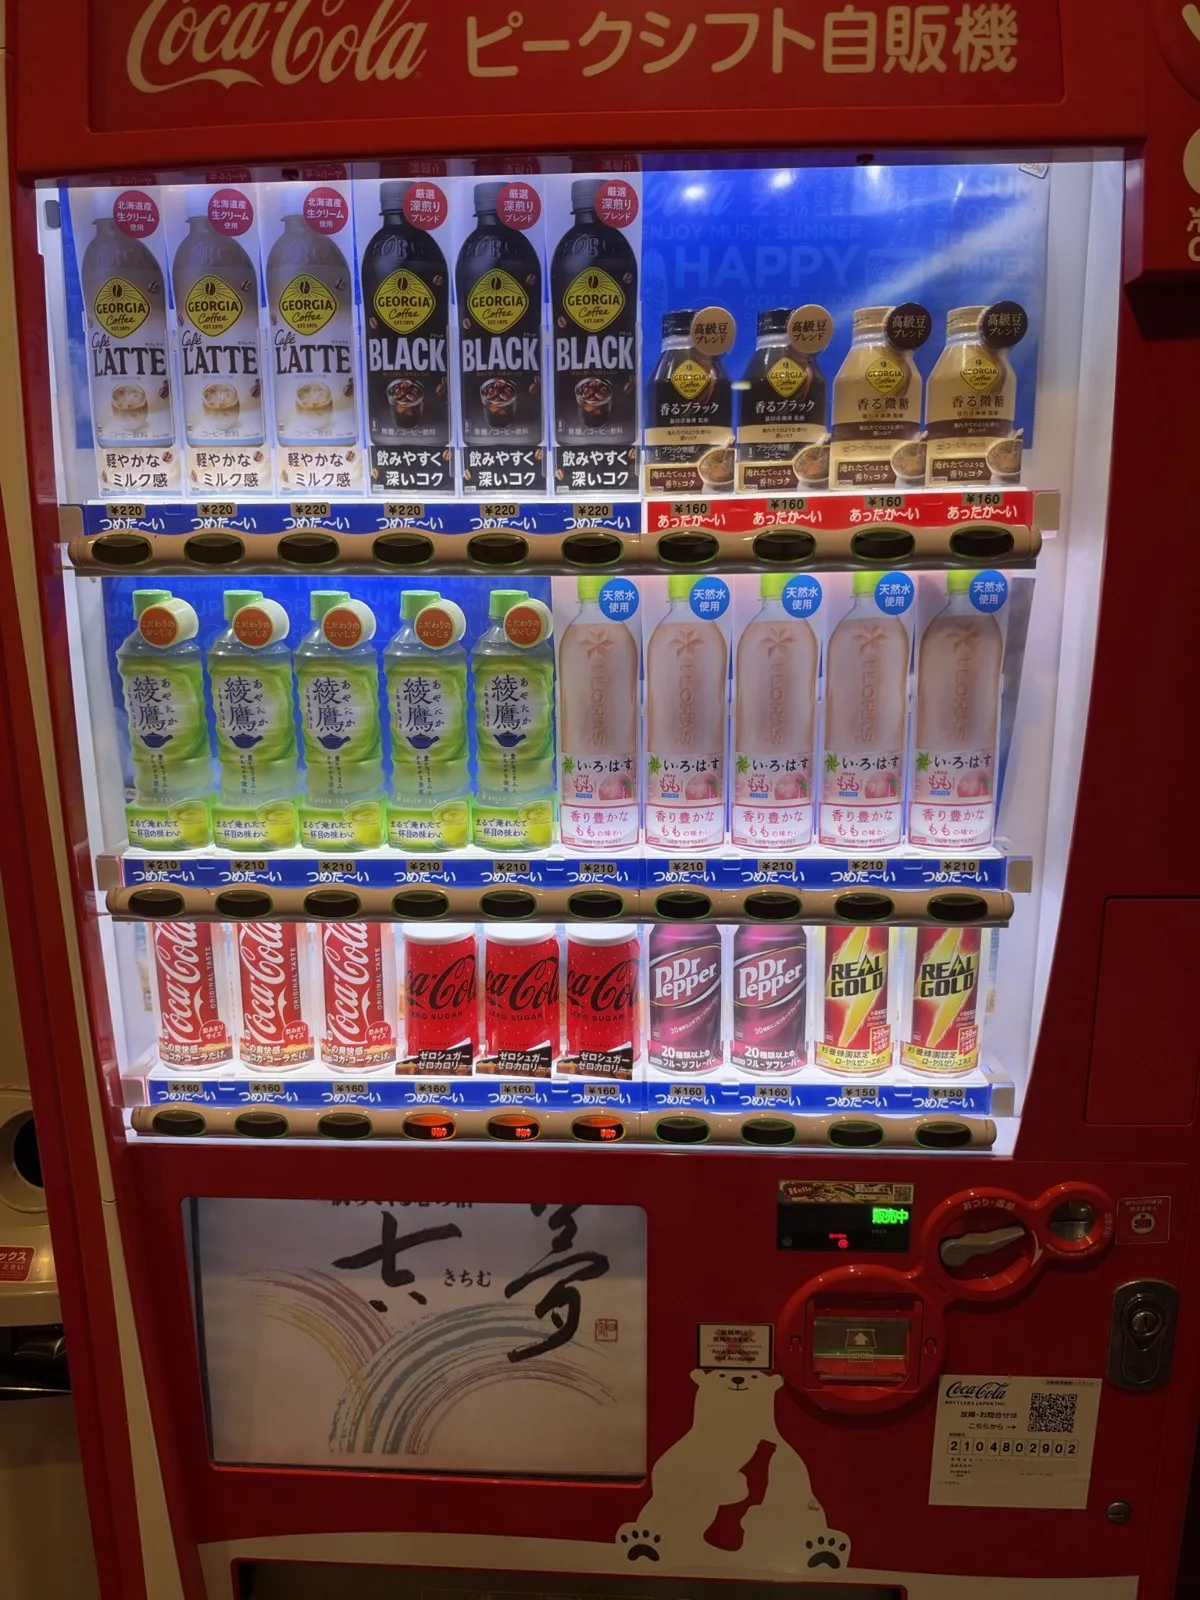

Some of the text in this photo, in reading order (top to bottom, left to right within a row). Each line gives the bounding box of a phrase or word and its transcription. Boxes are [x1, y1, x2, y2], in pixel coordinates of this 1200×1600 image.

[467, 3, 1018, 78] ピークシフト自販機
[415, 188, 434, 199] 厳選
[509, 188, 528, 199] 厳選
[607, 186, 627, 197] 厳選
[118, 201, 152, 210] 北海道産
[212, 200, 246, 209] 北海道産
[308, 198, 341, 207] 北海道産
[410, 201, 440, 212] 深煎り
[504, 201, 534, 212] 深煎り
[602, 198, 631, 210] 深煎り
[117, 212, 155, 222] 生クリーム
[212, 211, 249, 220] 生クリーム
[307, 209, 344, 219] 生クリーム
[412, 214, 440, 223] ブレンド
[505, 214, 533, 223] ブレンド
[603, 212, 631, 221] ブレンド
[675, 246, 859, 287] HAPPY
[378, 297, 430, 308] GEORGIA
[471, 297, 524, 307] GEORGIA
[567, 295, 620, 306] GEORGIA
[97, 303, 146, 314] GEORGIA
[188, 301, 237, 312] GEORGIA
[578, 307, 610, 318] Coffee
[106, 315, 135, 325] Coffee
[892, 315, 926, 329] 高級豆
[988, 313, 1022, 327] 高級豆
[695, 322, 729, 335] 高級豆
[894, 329, 924, 338] ブレンド
[696, 336, 726, 344] ブレンド
[369, 337, 445, 372] BLACK
[462, 337, 538, 371] BLACK
[556, 336, 634, 370] BLACK
[93, 348, 167, 376] LATTE
[183, 347, 257, 375] LATTE
[275, 345, 351, 374] LATTE
[755, 400, 814, 414] 香るブラック
[857, 398, 909, 410] 香る微糖
[952, 396, 1004, 408] 香る微糖
[660, 402, 719, 415] 香るブラック
[106, 454, 160, 467] 軽やかな
[196, 453, 250, 467] 軽やかな
[288, 453, 343, 466] 軽やかな
[376, 451, 441, 466] 飲みやすく
[470, 451, 534, 466] 飲みやすく
[563, 451, 627, 466] 飲みやすく
[113, 474, 168, 487] ミルク感
[203, 473, 258, 487] ミルク感
[295, 473, 350, 487] ミルク感
[386, 471, 443, 487] 深いコク
[478, 471, 535, 487] 深いコク
[572, 471, 628, 487] 深いコク
[868, 496, 901, 507] ¥160
[966, 494, 1000, 504] ¥160
[111, 505, 142, 515] ¥220
[295, 505, 327, 515] ¥220
[389, 505, 420, 516] ¥220
[578, 505, 609, 516] ¥220
[675, 504, 707, 514] ¥160
[786, 587, 818, 598] 天然水
[973, 582, 1005, 592] 天然水
[603, 590, 635, 601] 天然水
[979, 595, 998, 605] 使用
[700, 601, 720, 612] 使用
[792, 599, 812, 610] 使用
[132, 676, 167, 731] 綾鷹
[312, 676, 344, 731] 綾鷹
[491, 674, 521, 731] 綾鷹
[570, 811, 628, 823] 香り豊かな
[744, 811, 803, 824] 香り豊かな
[922, 809, 984, 822] 香り豊かな
[303, 820, 352, 829] まるで淹れたて
[303, 830, 355, 839] 一杯目の味わい
[148, 861, 177, 870] ¥210
[322, 862, 352, 871] ¥210
[497, 863, 527, 871] ¥210
[584, 864, 613, 873] ¥210
[762, 862, 792, 870] ¥210
[944, 862, 975, 871] ¥210
[205, 947, 214, 974] TASTE
[758, 957, 787, 975] Dr
[673, 957, 701, 976] Dr
[832, 954, 883, 980] REAL
[922, 954, 973, 980] REAL
[655, 963, 717, 1000] Pepper
[739, 964, 803, 1000] Pepper
[831, 972, 883, 997] GOLD
[921, 971, 973, 998] GOLD
[431, 1011, 463, 1019] SUGAR
[592, 1013, 624, 1022] SUGAR
[420, 1052, 470, 1061] ゼロシュガー
[580, 1052, 630, 1063] ゼロシュガー
[661, 1047, 710, 1058] 20種類以上の
[744, 1047, 795, 1058] 20種類以上の
[253, 1084, 280, 1092] ¥160
[336, 1084, 364, 1092] ¥160
[504, 1085, 531, 1094] ¥160
[588, 1086, 615, 1095] ¥160
[759, 1088, 787, 1096] ¥160
[846, 1089, 875, 1097] ¥150
[933, 1089, 963, 1097] ¥150
[443, 1268, 491, 1288] きちむ
[945, 1381, 1010, 1399] Coca-Cola
